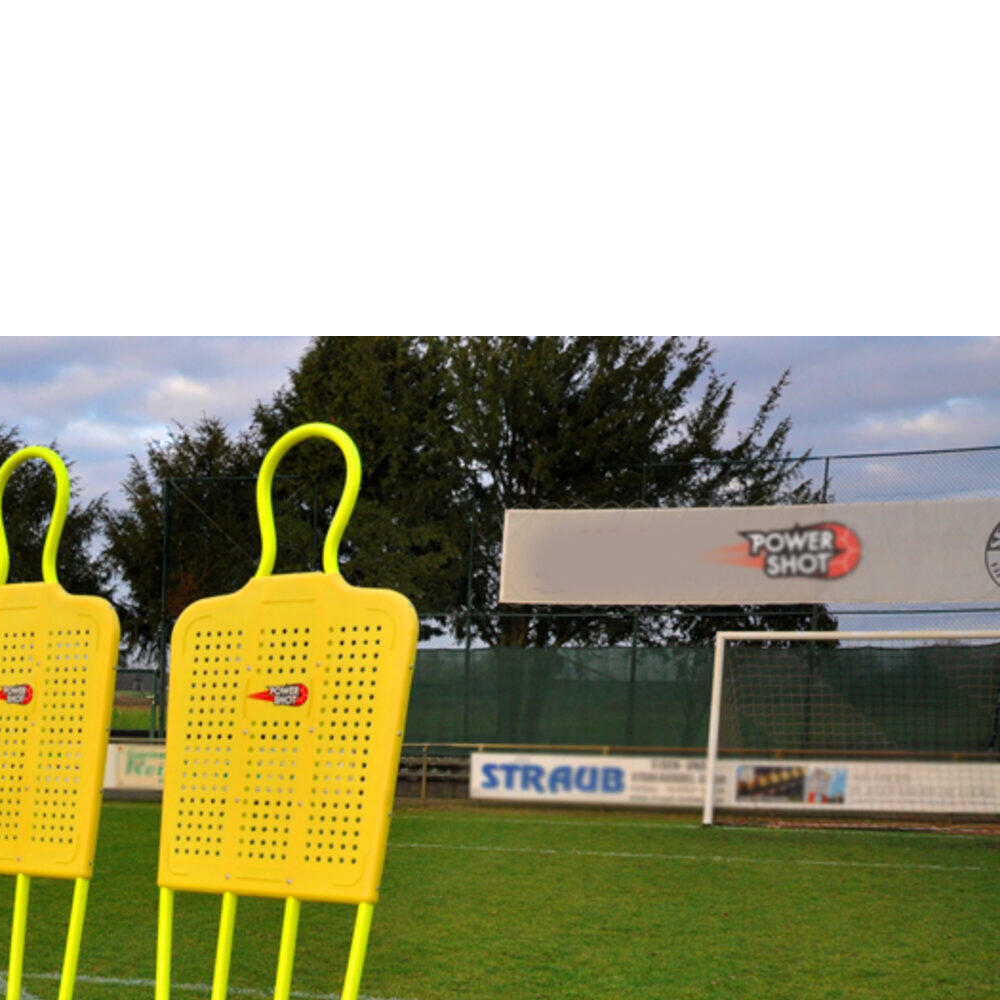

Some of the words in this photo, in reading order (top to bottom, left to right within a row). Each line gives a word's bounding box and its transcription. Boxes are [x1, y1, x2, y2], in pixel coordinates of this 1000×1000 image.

[750, 529, 836, 553] POWER
[766, 553, 832, 577] SHOT
[480, 763, 626, 794] STRAUB
